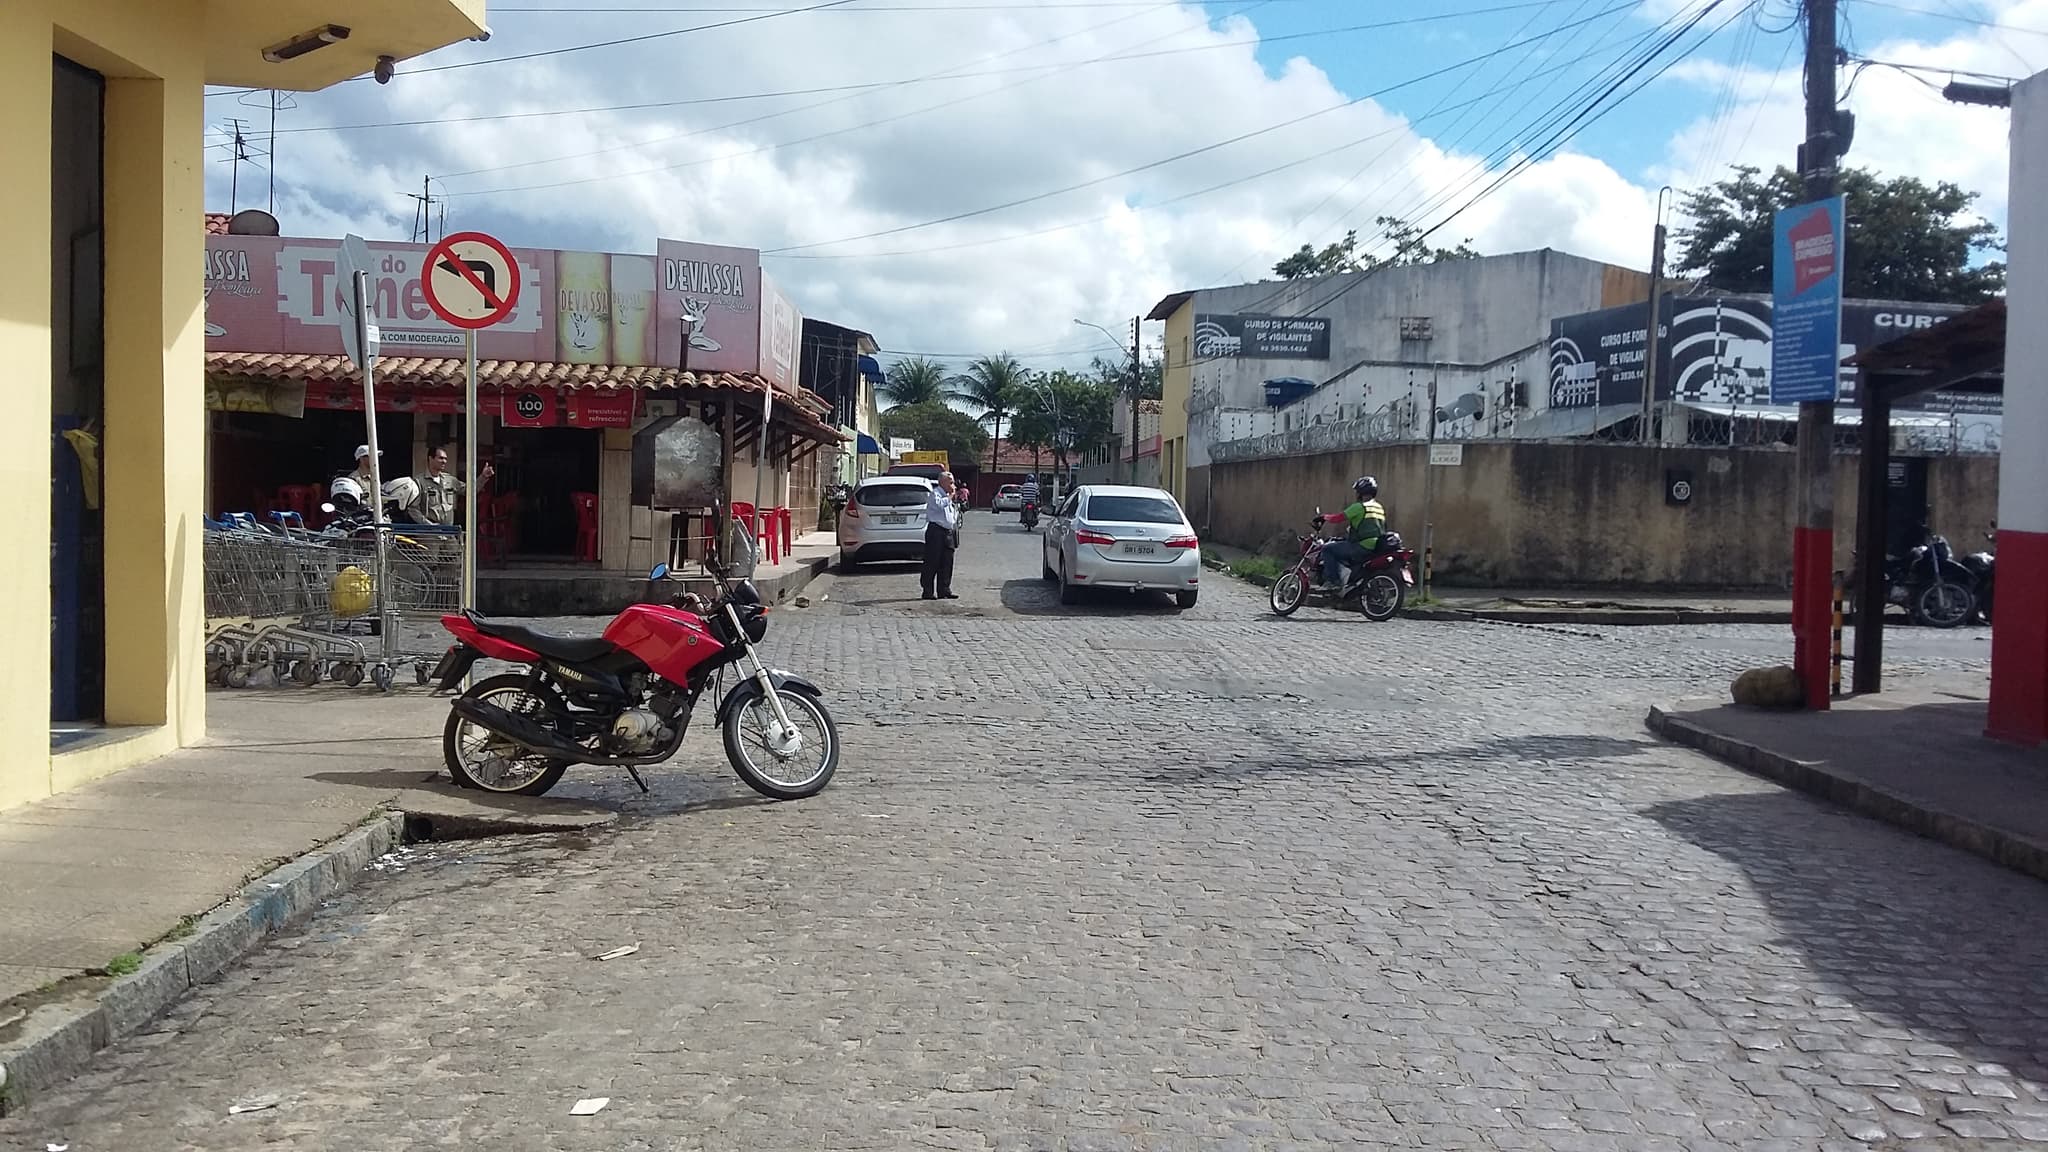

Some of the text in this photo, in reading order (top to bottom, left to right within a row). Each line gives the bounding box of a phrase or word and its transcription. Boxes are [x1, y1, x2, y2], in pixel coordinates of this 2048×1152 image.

[381, 254, 407, 273] do
[665, 258, 744, 297] DEVASSA
[561, 289, 609, 314] DEVASSA
[1244, 320, 1325, 331] CURSO DE FORMAÇÃO
[388, 333, 407, 343] COM
[408, 333, 461, 345] MODERAÇÃO
[1256, 333, 1313, 342] DE VIGILANTES
[1600, 333, 1621, 347] CURSO
[1622, 331, 1631, 344] DE
[1609, 353, 1618, 365] DE
[517, 400, 543, 412] 1.00
[558, 664, 582, 681] YAMAHA
